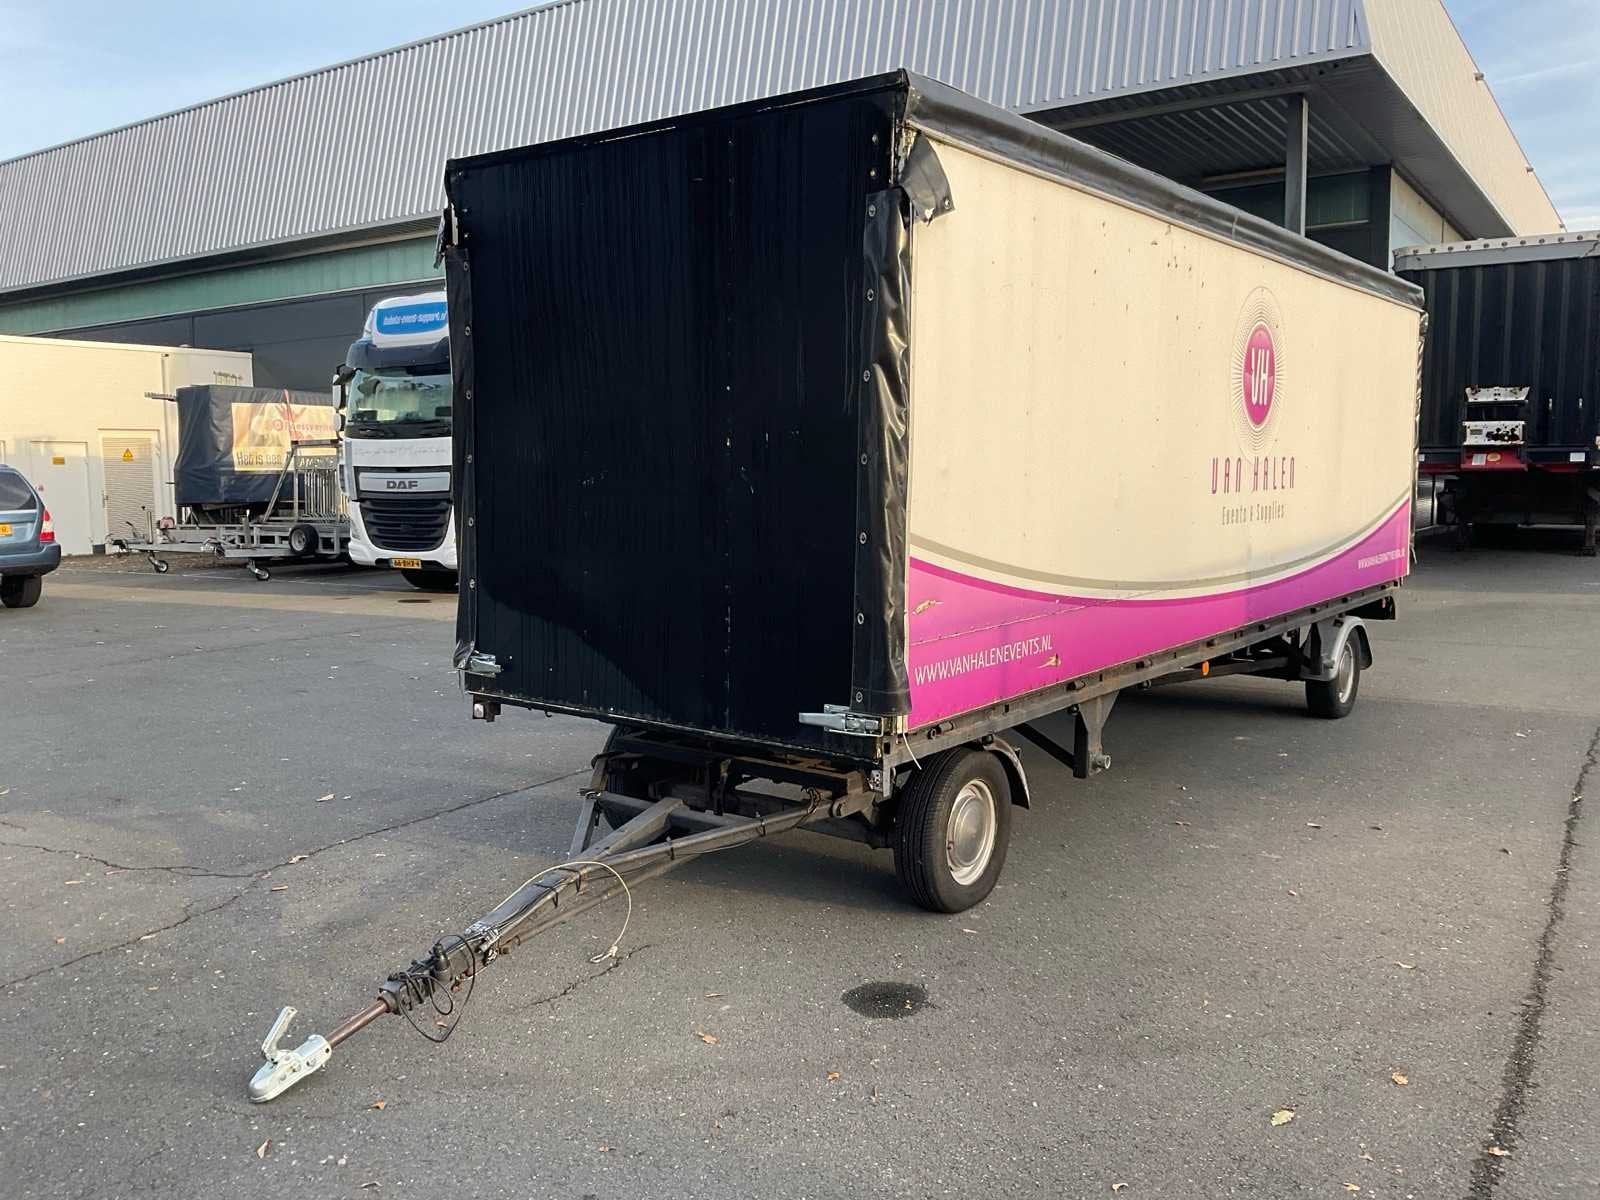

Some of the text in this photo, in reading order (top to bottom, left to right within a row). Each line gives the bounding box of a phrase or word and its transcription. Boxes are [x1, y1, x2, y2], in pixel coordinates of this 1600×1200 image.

[1250, 348, 1270, 406] VH
[236, 451, 254, 466] Het
[255, 452, 264, 465] is
[1211, 455, 1295, 495] VAN HALEN
[386, 480, 418, 489] DAF
[1221, 505, 1247, 526] Events
[1256, 500, 1285, 524] Supplies
[914, 634, 1053, 687] WWW.VANHALENEVENTS.NL
